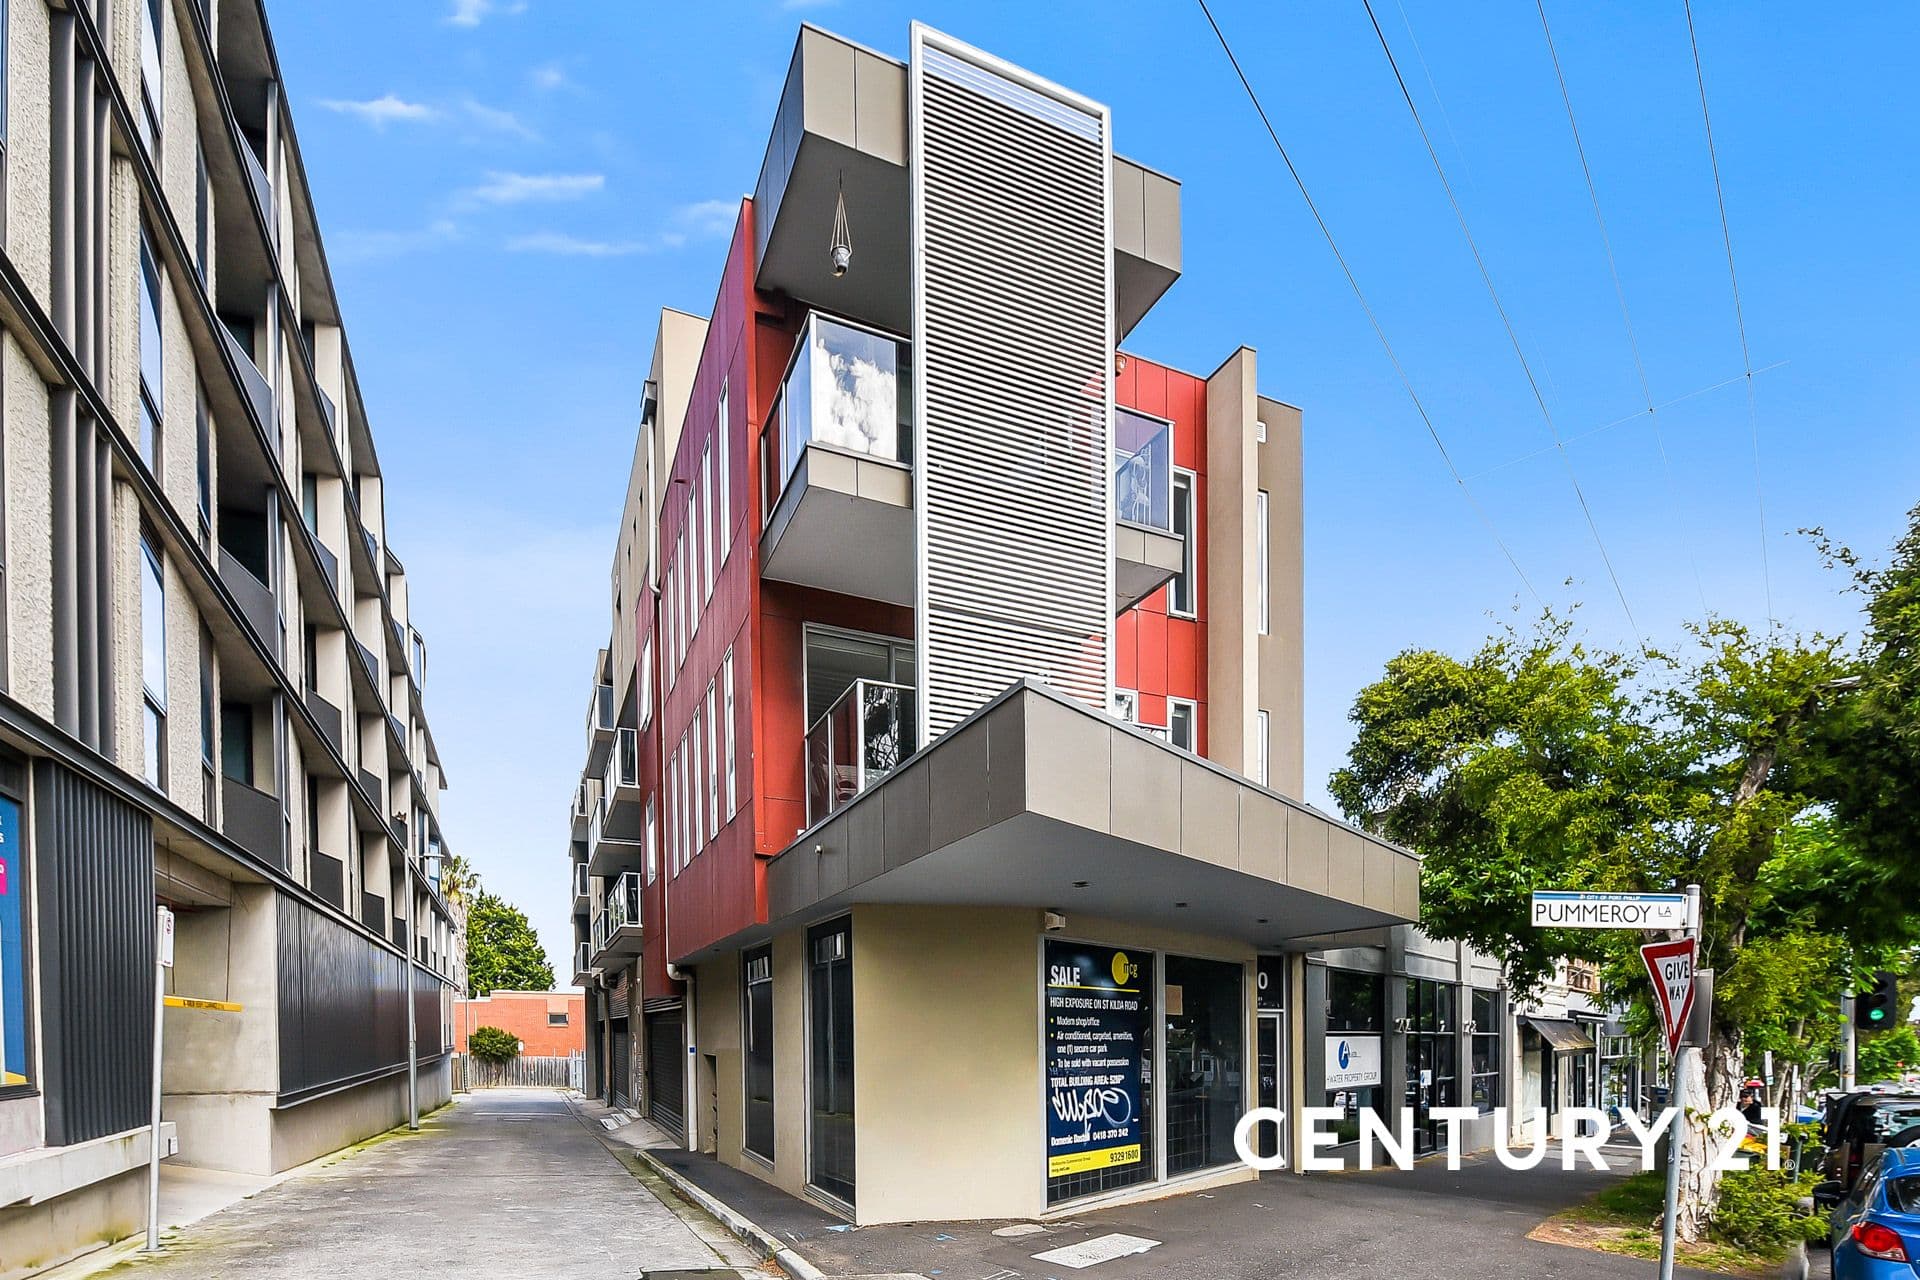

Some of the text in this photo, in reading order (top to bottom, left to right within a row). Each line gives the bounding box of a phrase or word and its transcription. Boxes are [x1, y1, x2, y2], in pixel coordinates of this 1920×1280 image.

[1535, 903, 1672, 923] PUMMEROY LA
[1050, 965, 1081, 987] SALE
[1665, 960, 1690, 981] GIVE
[1669, 985, 1687, 1001] WAY
[1050, 996, 1138, 1011] HIGH EXPOSURE ON ST KILDA ROAD
[1056, 1016, 1100, 1027] Modern shop/office
[1056, 1031, 1064, 1041] Air
[1065, 1031, 1092, 1042] conditioned,
[1074, 1045, 1089, 1053] secure
[1089, 1045, 1097, 1053] car
[1097, 1044, 1108, 1054] park
[1057, 1059, 1063, 1068] To
[1064, 1059, 1070, 1067] be
[1071, 1058, 1081, 1067] sold
[1081, 1058, 1092, 1067] with
[1092, 1058, 1106, 1067] vacant
[1050, 1077, 1069, 1088] TOTAL
[1068, 1075, 1093, 1087] BUILDING
[1051, 1135, 1074, 1147] Domenic
[1092, 1131, 1107, 1141] 0418
[1107, 1129, 1118, 1139] 370
[1117, 1127, 1129, 1138] 242
[1109, 1149, 1139, 1163] 9329 1600
